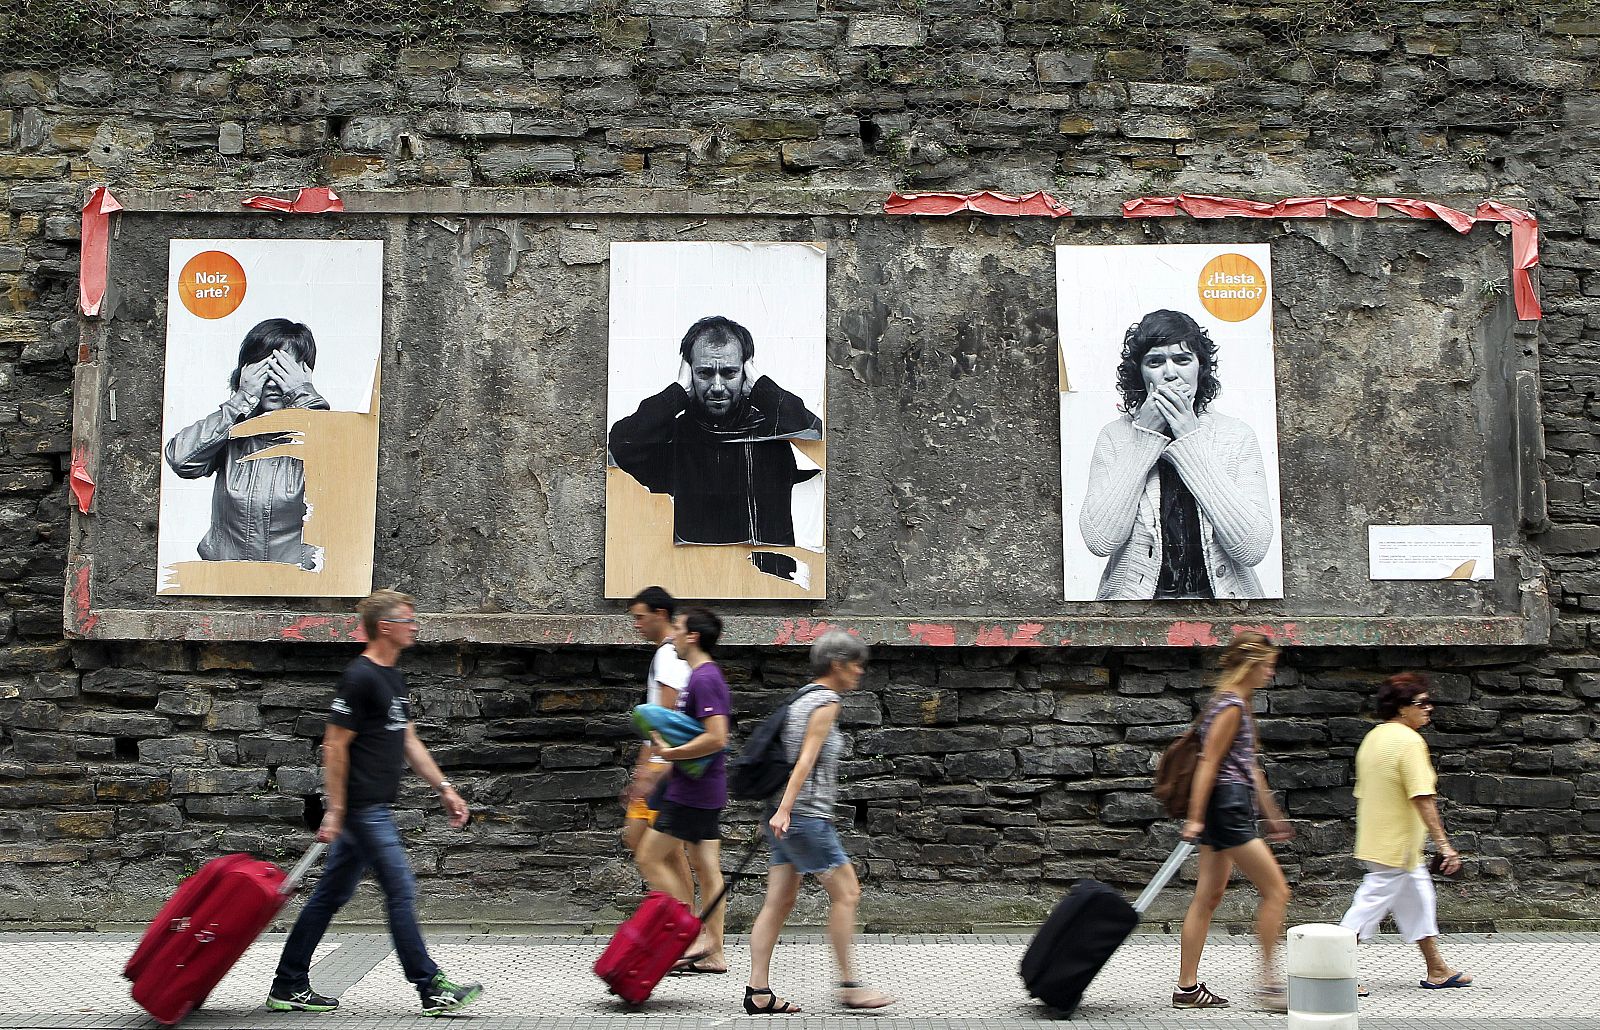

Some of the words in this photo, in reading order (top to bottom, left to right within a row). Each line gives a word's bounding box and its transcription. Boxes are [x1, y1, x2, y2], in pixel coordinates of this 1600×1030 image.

[195, 272, 227, 284] Noiz
[1207, 272, 1255, 286] ¿Hasta
[195, 285, 230, 299] arte?
[1203, 287, 1263, 299] cuando?
